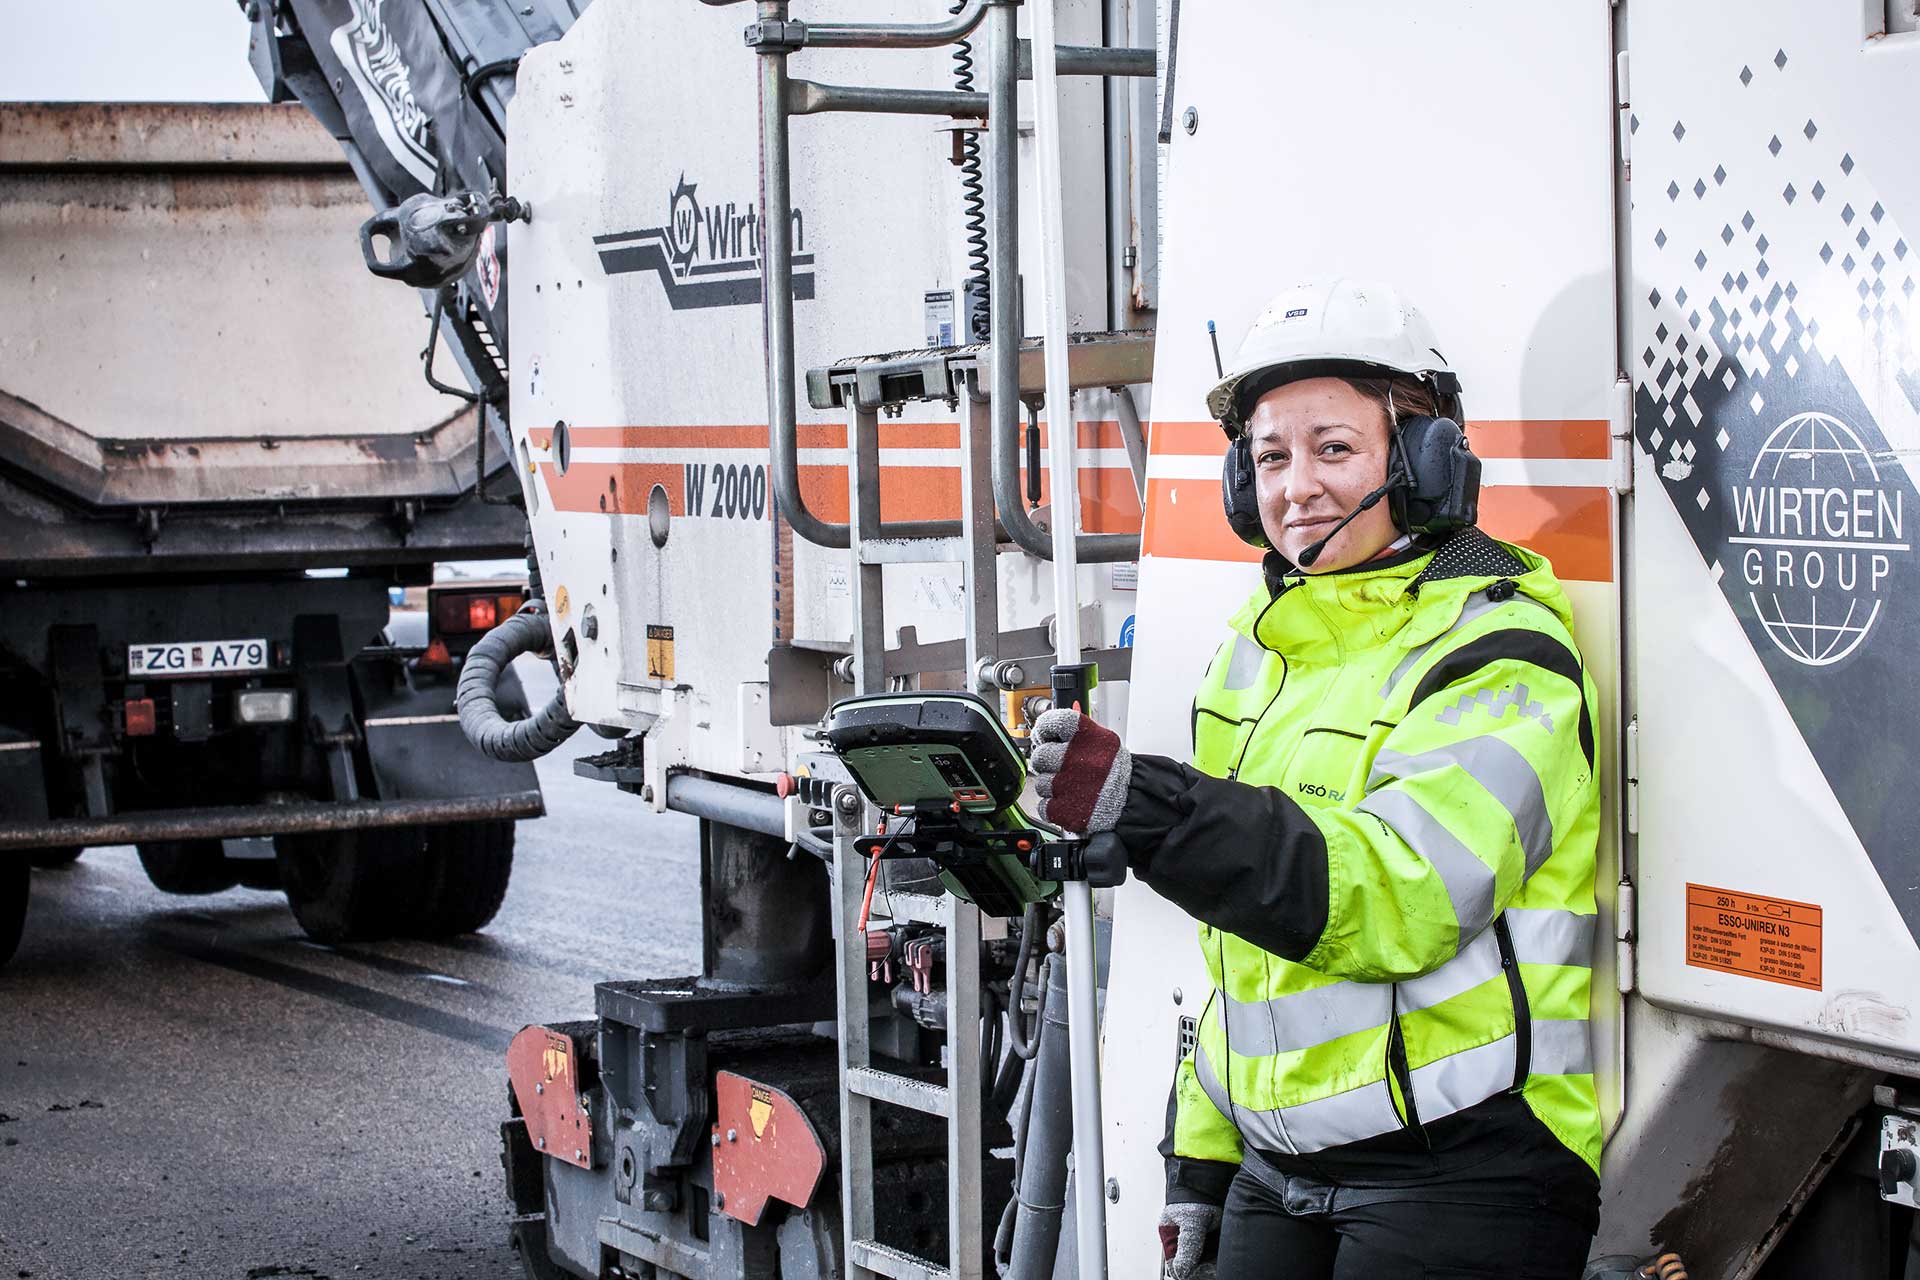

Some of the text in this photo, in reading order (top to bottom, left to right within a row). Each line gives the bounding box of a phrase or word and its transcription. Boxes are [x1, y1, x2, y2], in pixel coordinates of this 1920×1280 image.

[676, 209, 692, 245] W
[705, 201, 804, 260] Wirtn
[686, 463, 765, 520] W 2000
[1732, 486, 1903, 539] WIRTGEN
[1743, 548, 1889, 591] GROUP
[147, 647, 185, 669] ZG
[211, 644, 262, 667] A79
[1299, 782, 1326, 797] VSÓ
[1717, 896, 1729, 907] 250
[1730, 898, 1736, 908] h
[1718, 913, 1790, 937] ESSO-UNIREX N3
